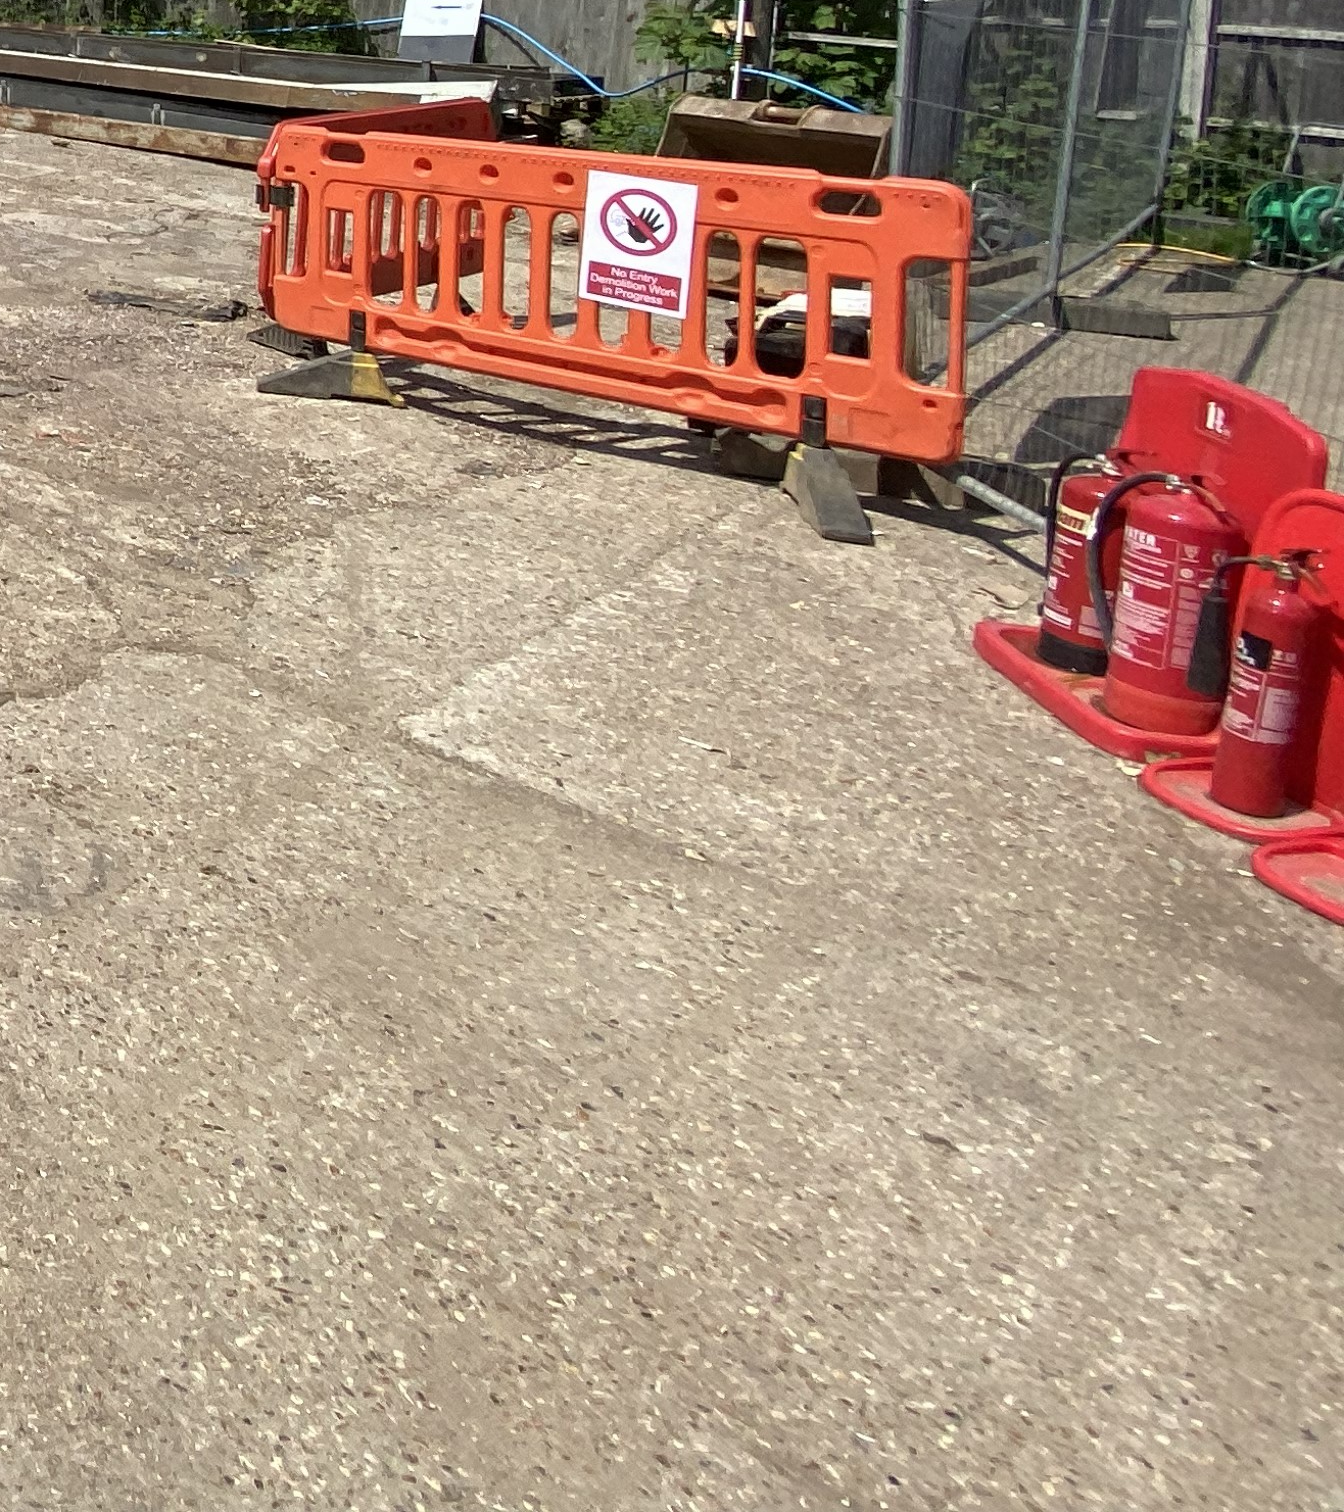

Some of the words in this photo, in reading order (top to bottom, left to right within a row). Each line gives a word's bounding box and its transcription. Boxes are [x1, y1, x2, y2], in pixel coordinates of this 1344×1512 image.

[590, 272, 646, 291] Demolition
[648, 284, 677, 298] Work
[610, 267, 627, 278] No
[629, 271, 658, 285] Entry
[601, 285, 613, 296] in
[614, 287, 663, 305] Progress
